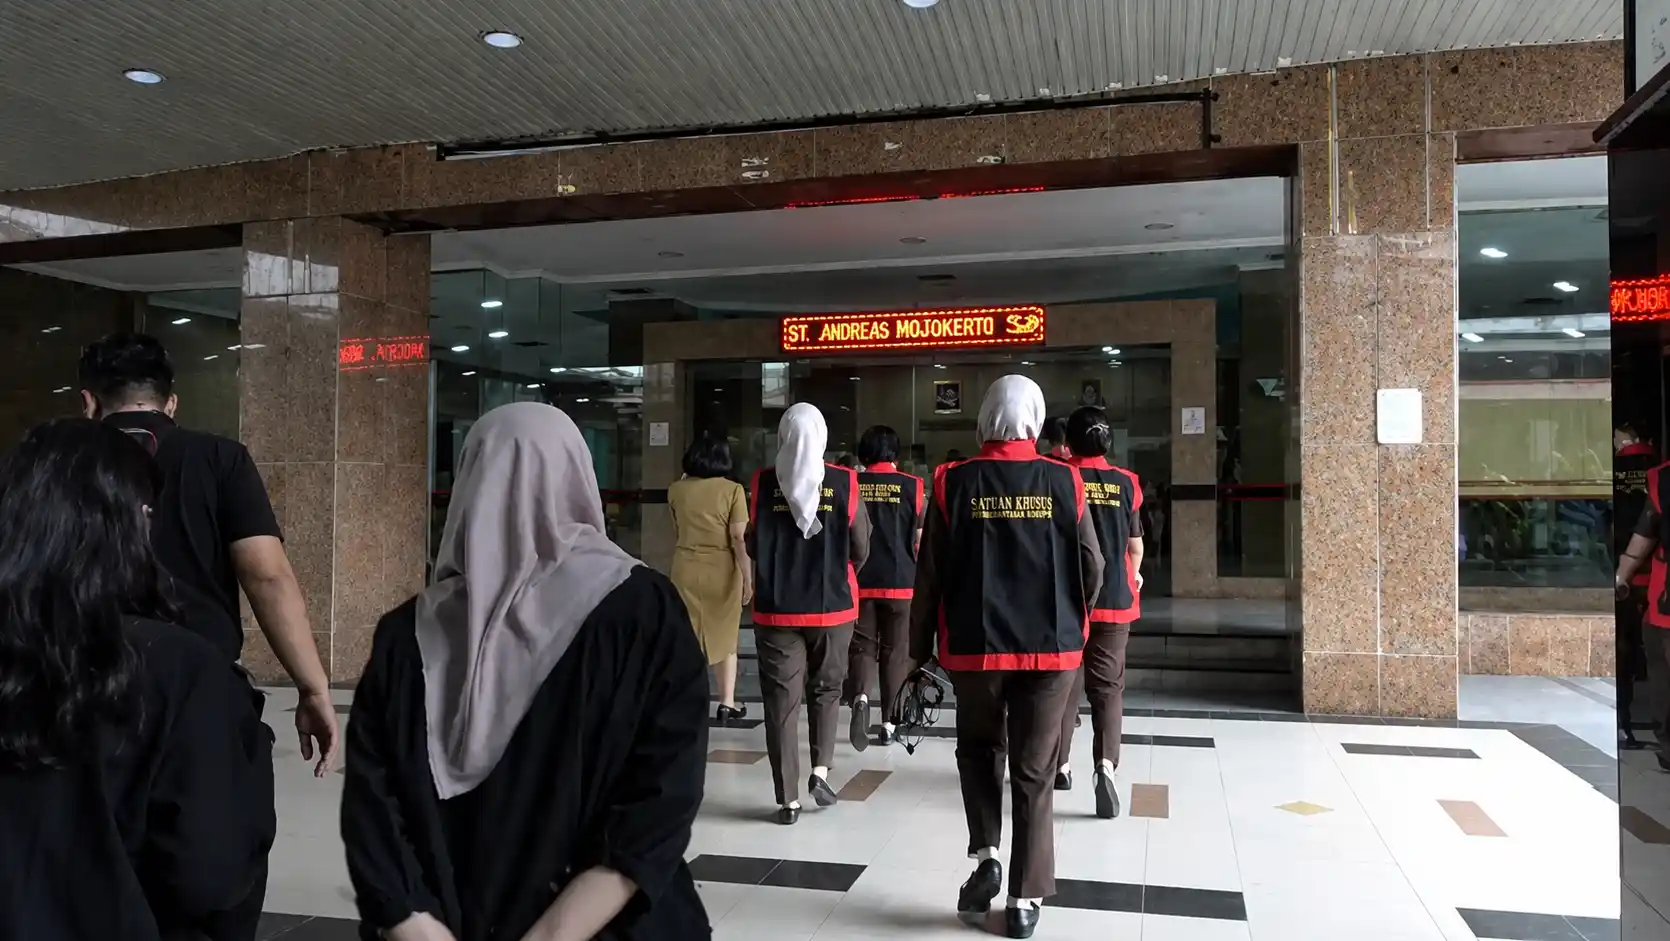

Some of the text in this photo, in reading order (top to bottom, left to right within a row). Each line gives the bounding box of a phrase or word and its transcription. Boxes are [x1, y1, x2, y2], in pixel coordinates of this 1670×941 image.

[788, 317, 994, 342] ST. ANDREAS MOJOKERTO
[971, 496, 1053, 511] SATUAN KHUSUS
